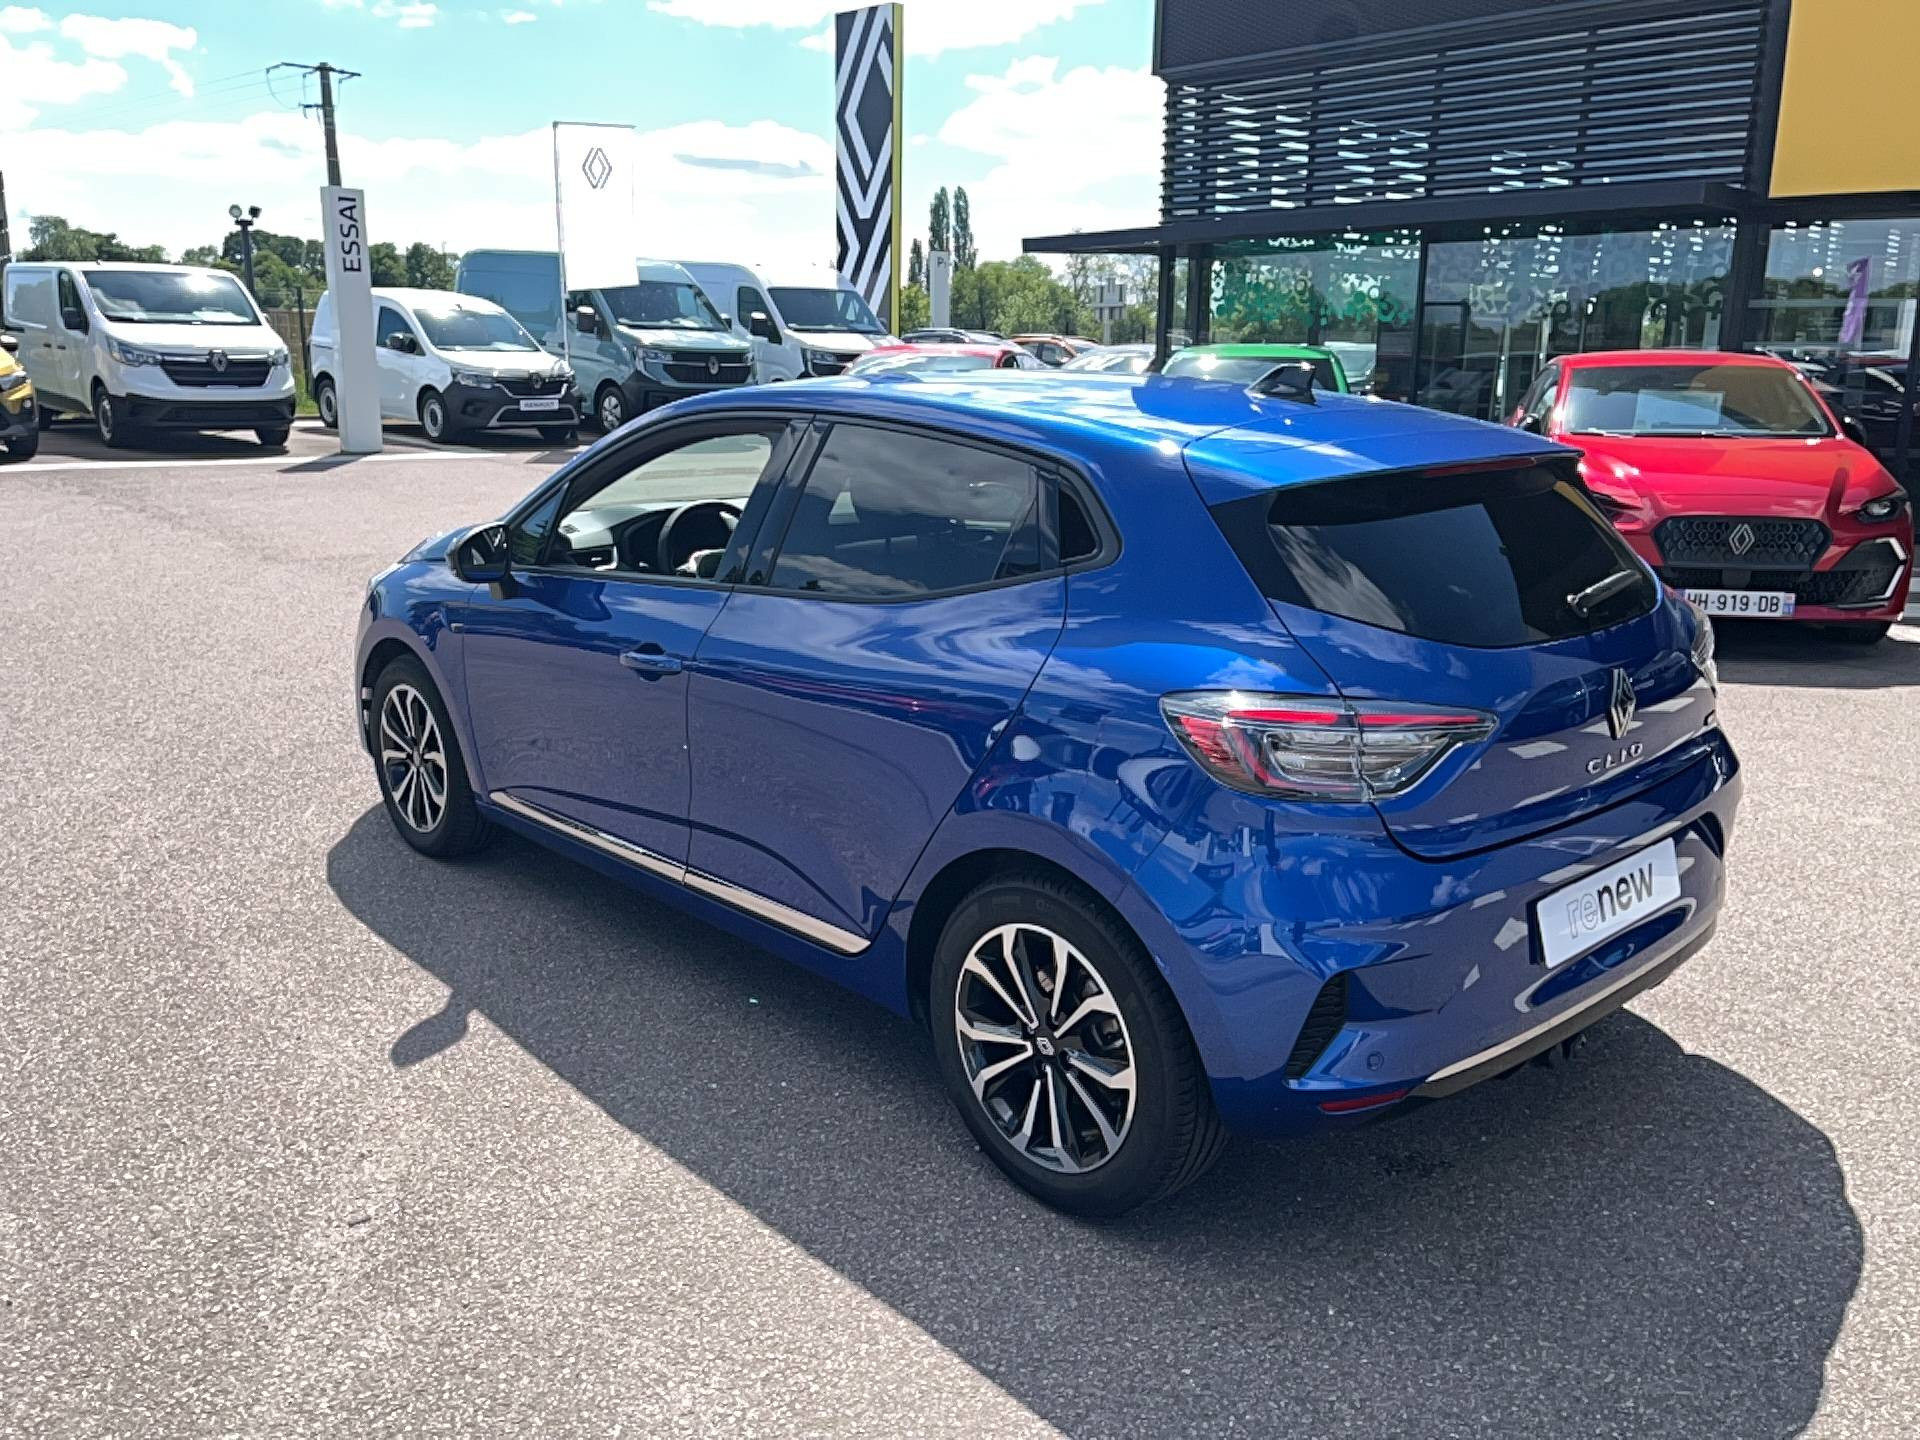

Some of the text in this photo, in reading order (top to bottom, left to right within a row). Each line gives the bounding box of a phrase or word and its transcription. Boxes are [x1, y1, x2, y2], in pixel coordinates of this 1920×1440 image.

[338, 196, 361, 272] ESSAI
[1586, 742, 1643, 775] CLIO
[1566, 862, 1653, 940] renew
